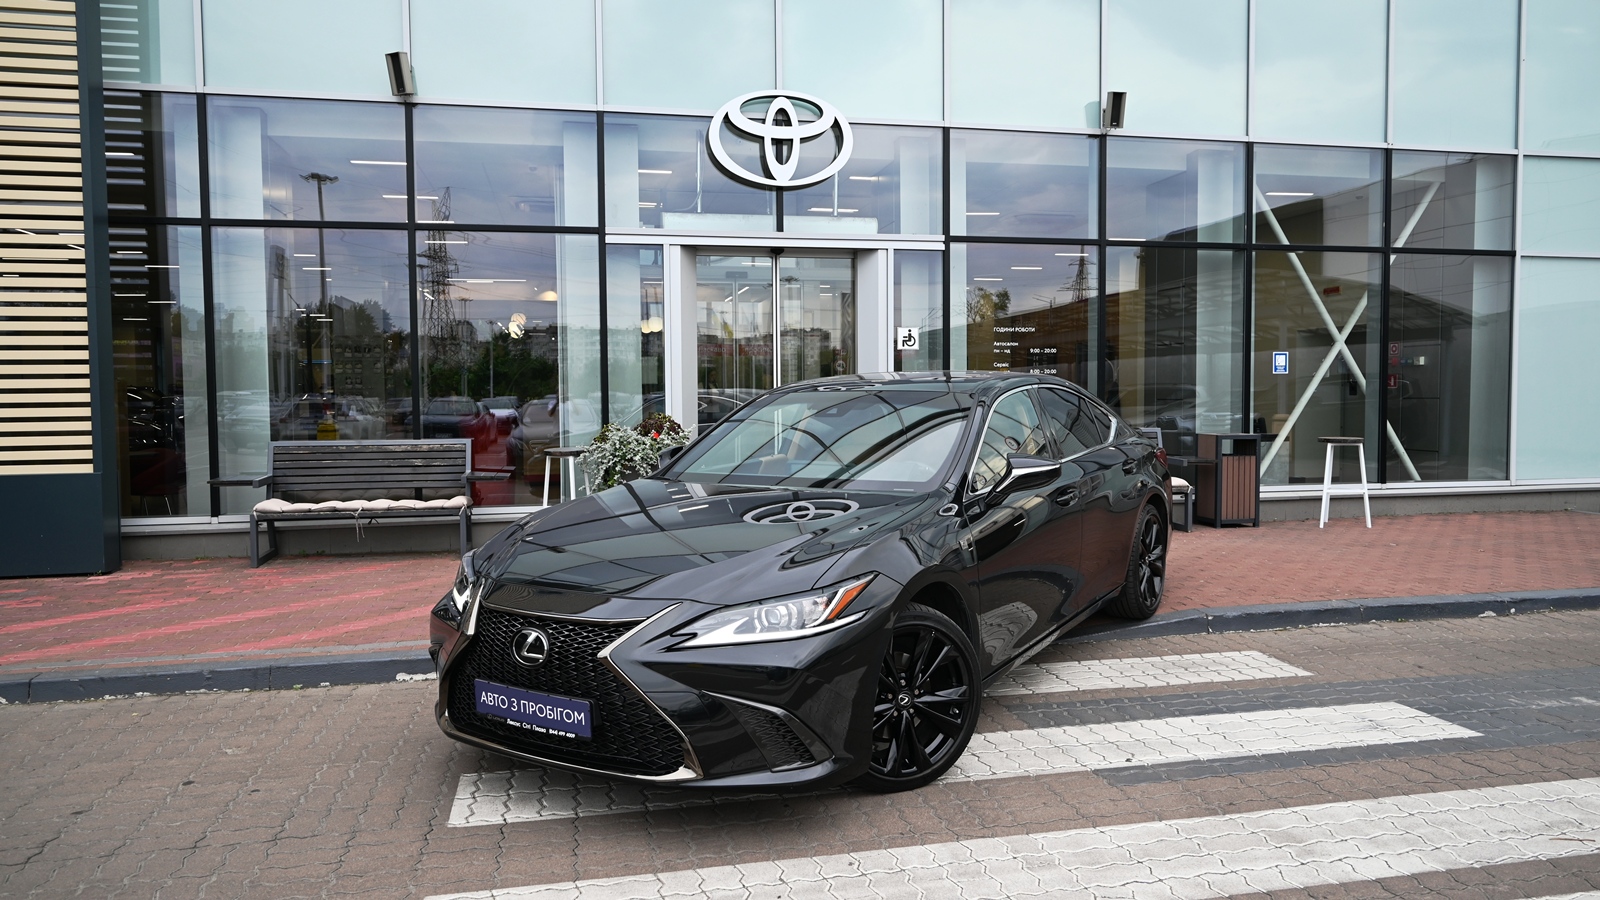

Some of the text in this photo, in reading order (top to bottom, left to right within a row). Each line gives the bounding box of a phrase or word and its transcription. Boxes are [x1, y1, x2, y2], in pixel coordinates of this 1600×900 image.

[480, 691, 585, 725] АВТО З ПРОБІГОМ
[506, 718, 521, 727] Лексус
[532, 725, 547, 733] Плаза
